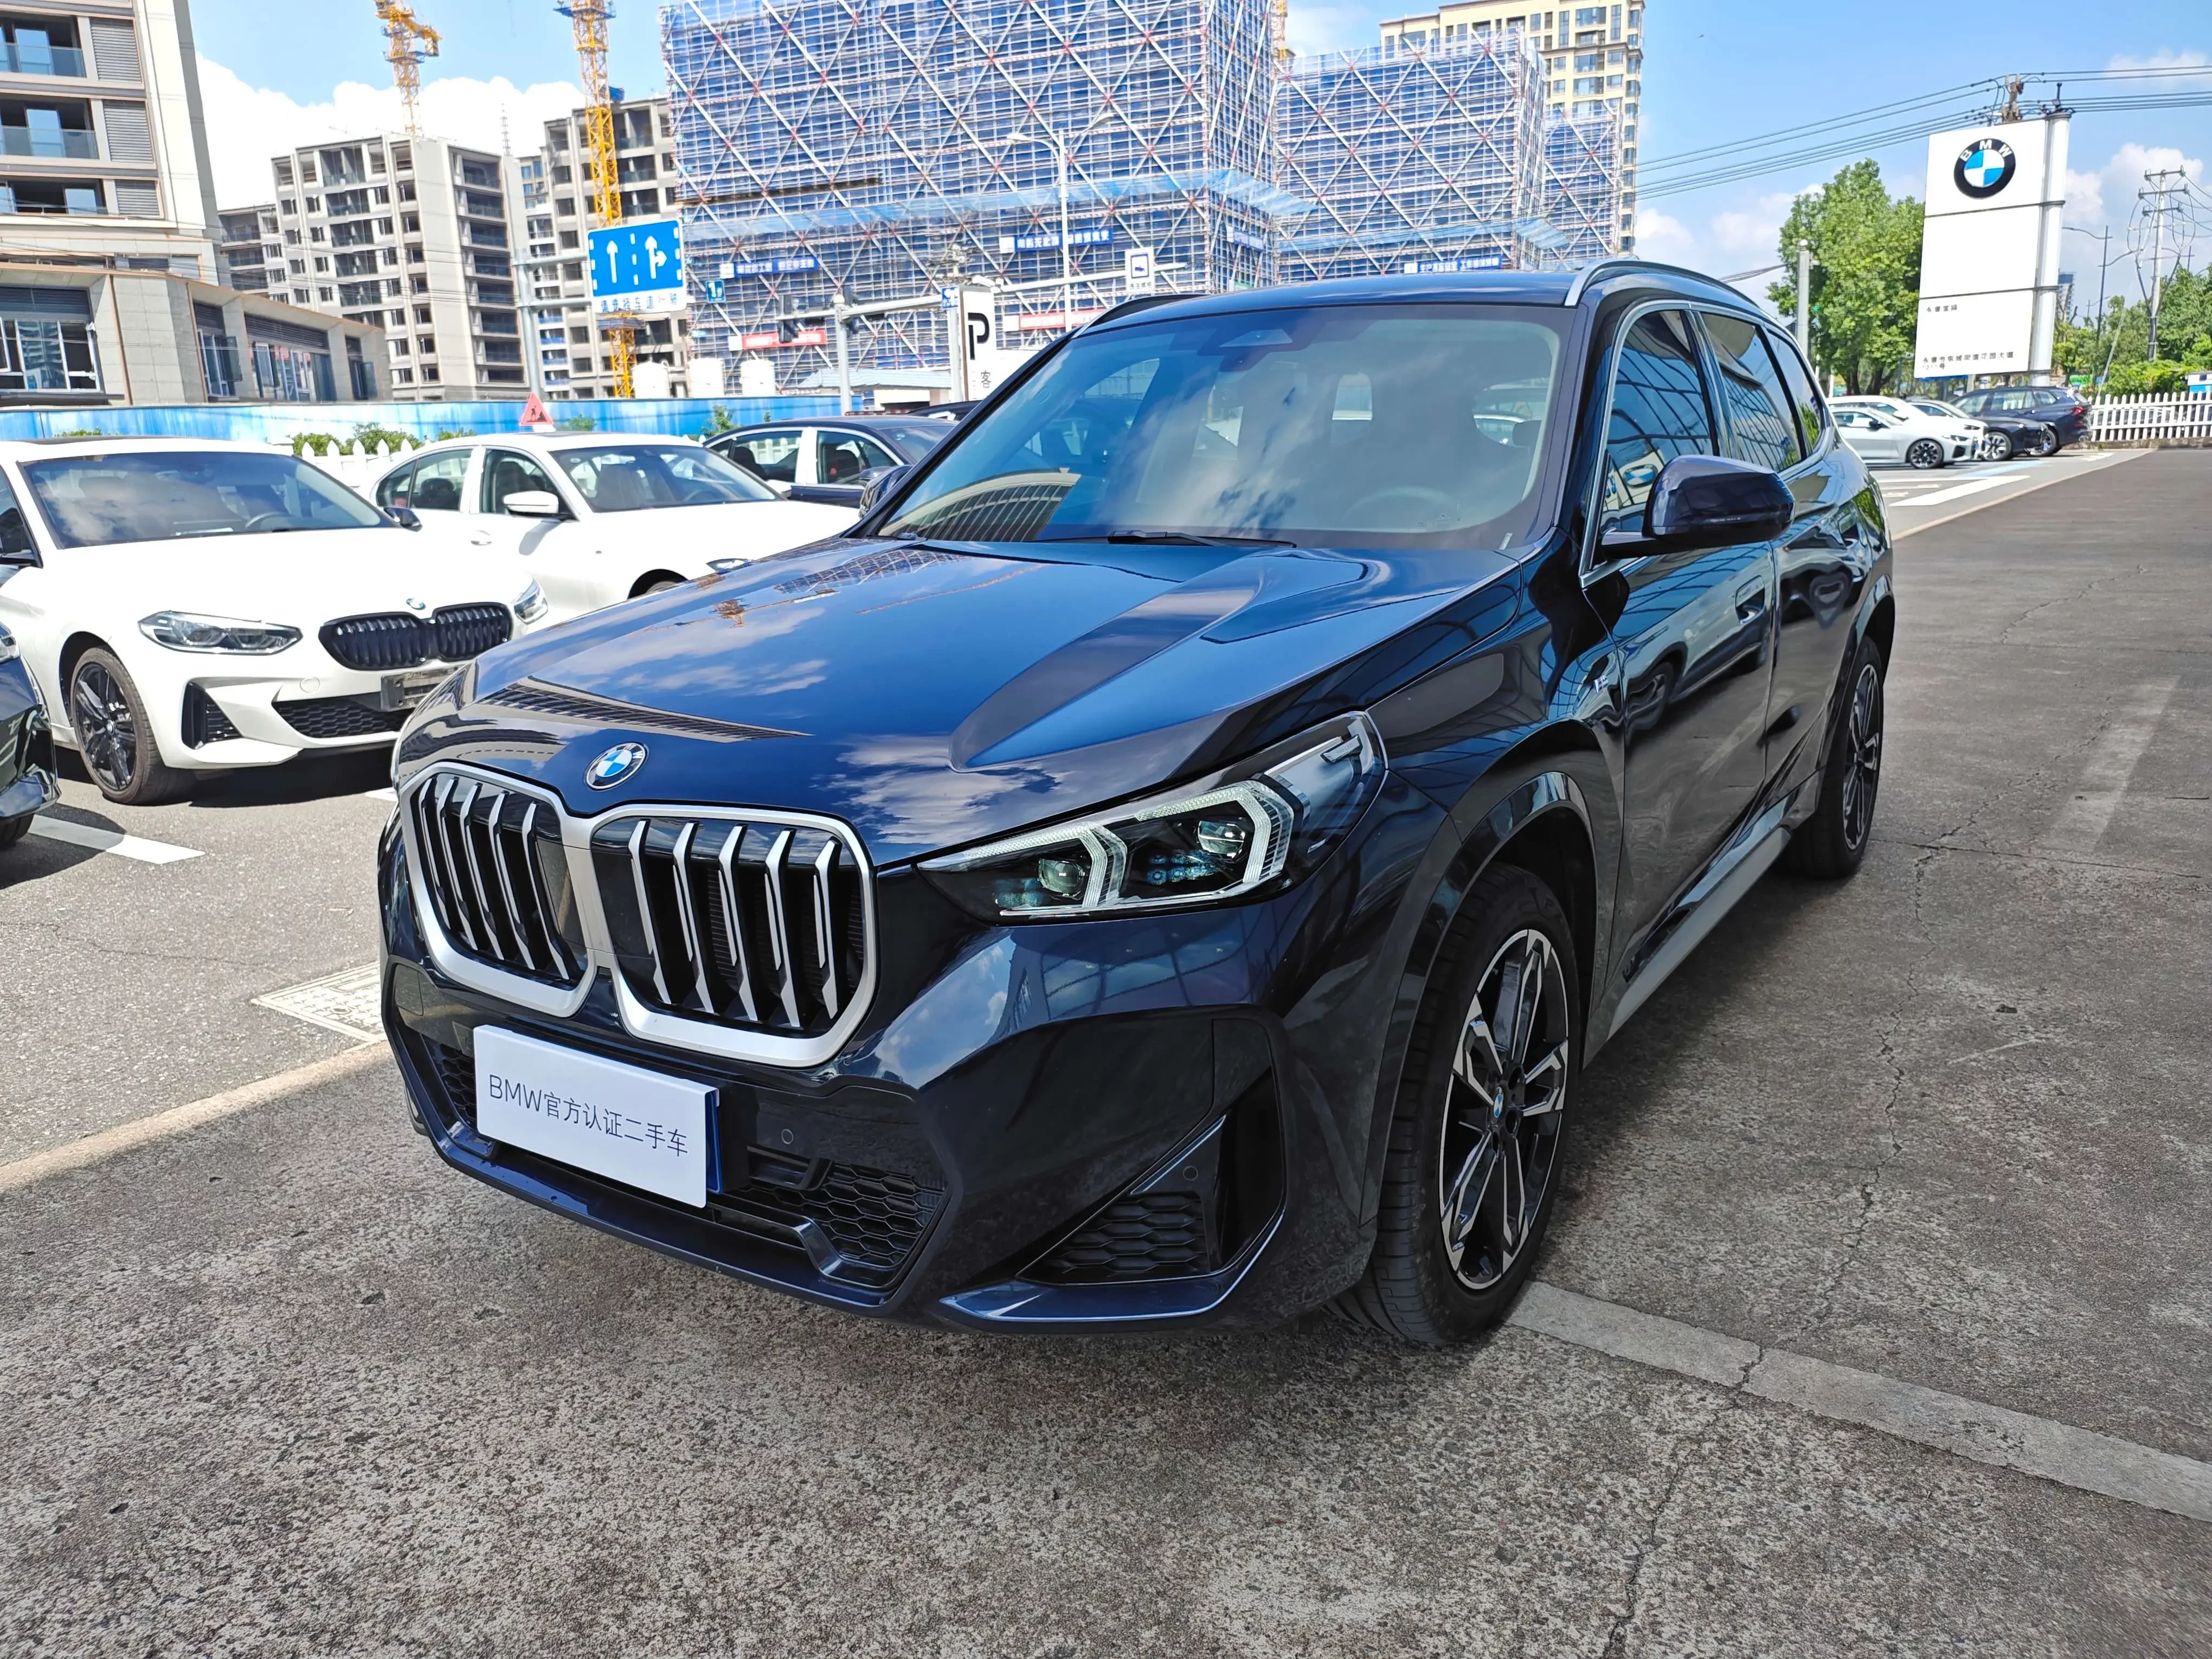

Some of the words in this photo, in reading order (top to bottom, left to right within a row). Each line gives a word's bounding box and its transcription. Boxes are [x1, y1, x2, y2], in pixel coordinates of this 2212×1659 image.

[1959, 139, 2013, 162] BMW
[967, 312, 990, 361] P
[489, 1074, 689, 1157] BMW官方认证二手车
